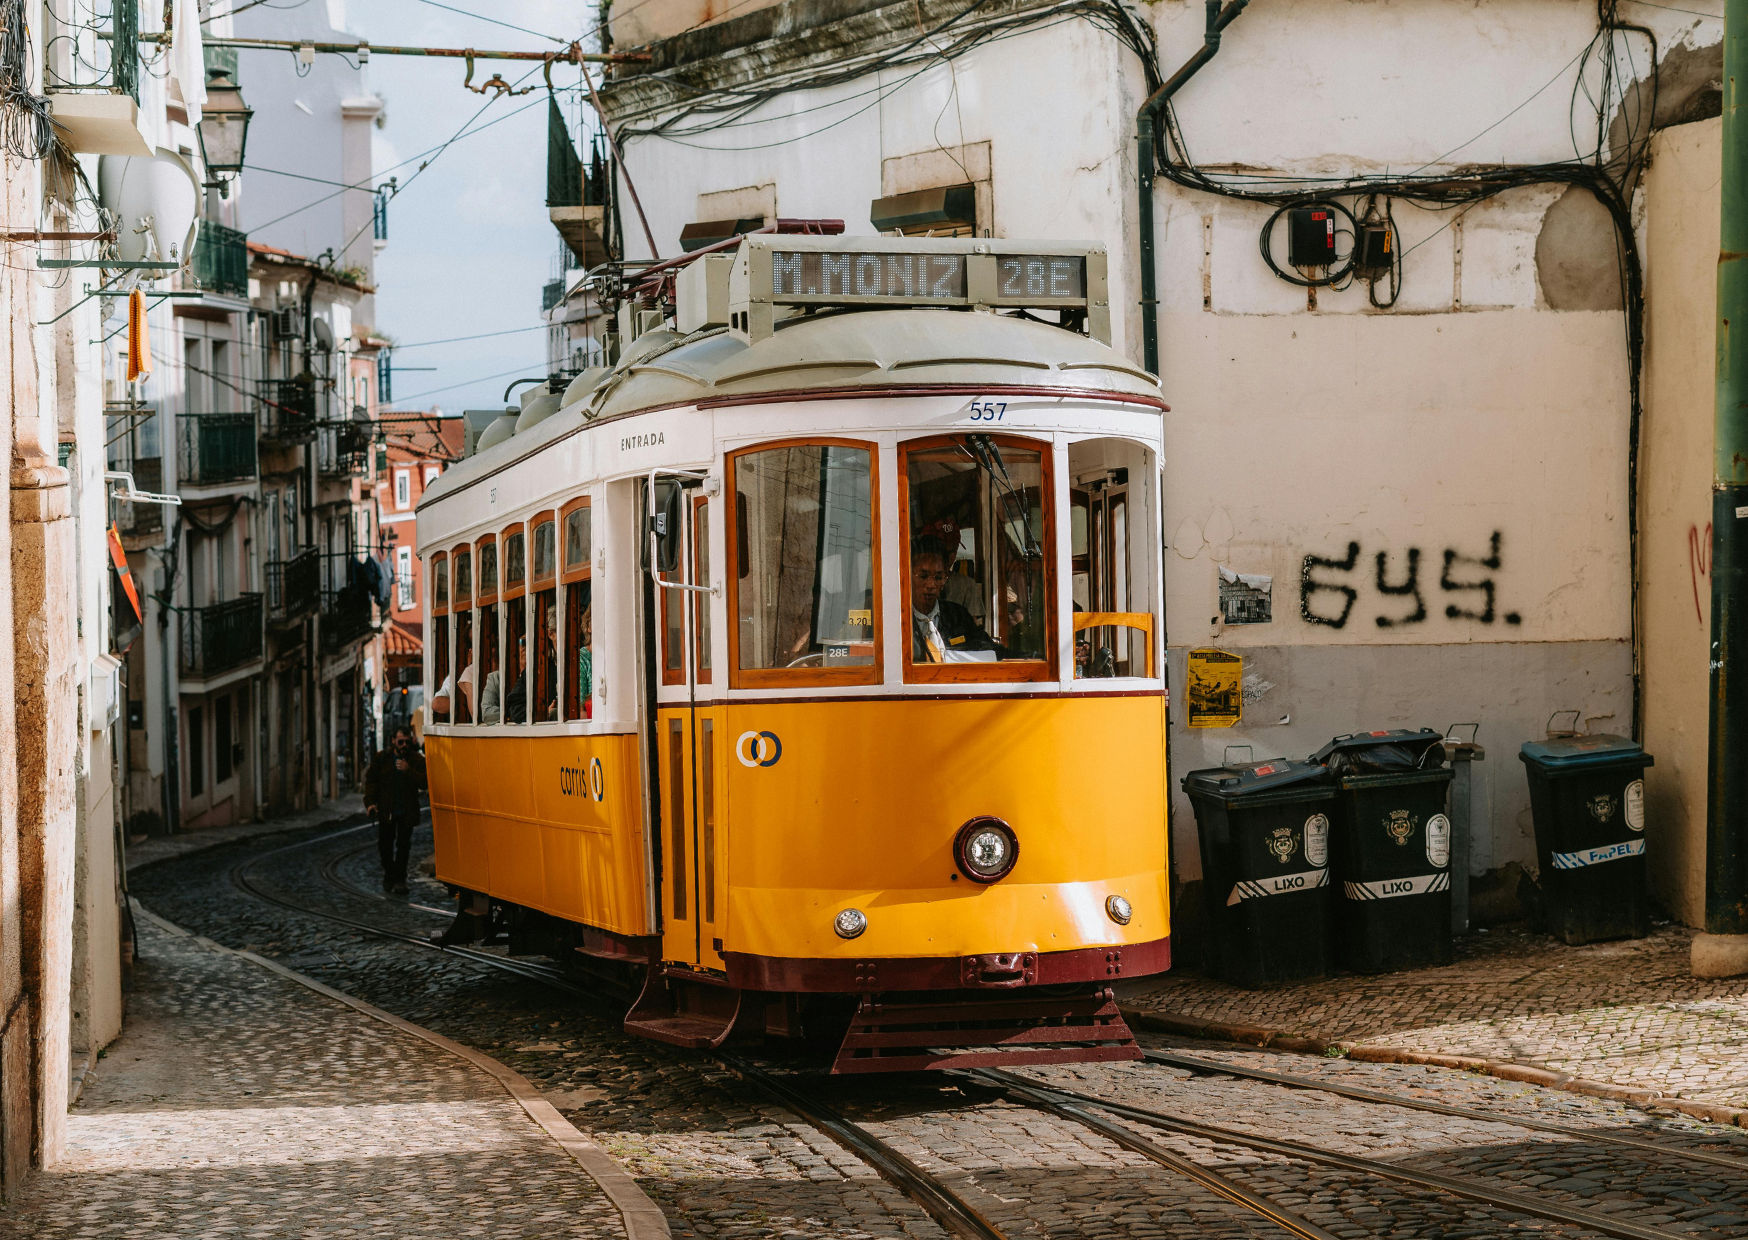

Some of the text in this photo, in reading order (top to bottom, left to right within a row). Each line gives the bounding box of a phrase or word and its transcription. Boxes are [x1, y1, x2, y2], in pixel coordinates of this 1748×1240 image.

[773, 252, 1070, 298] M.MONIZ 28E
[970, 402, 1007, 421] 557
[621, 431, 665, 451] ENTRADA
[829, 648, 847, 657] 28E
[560, 755, 587, 798] carris
[1274, 876, 1305, 891] LIXO
[1382, 881, 1413, 895] LIXO
